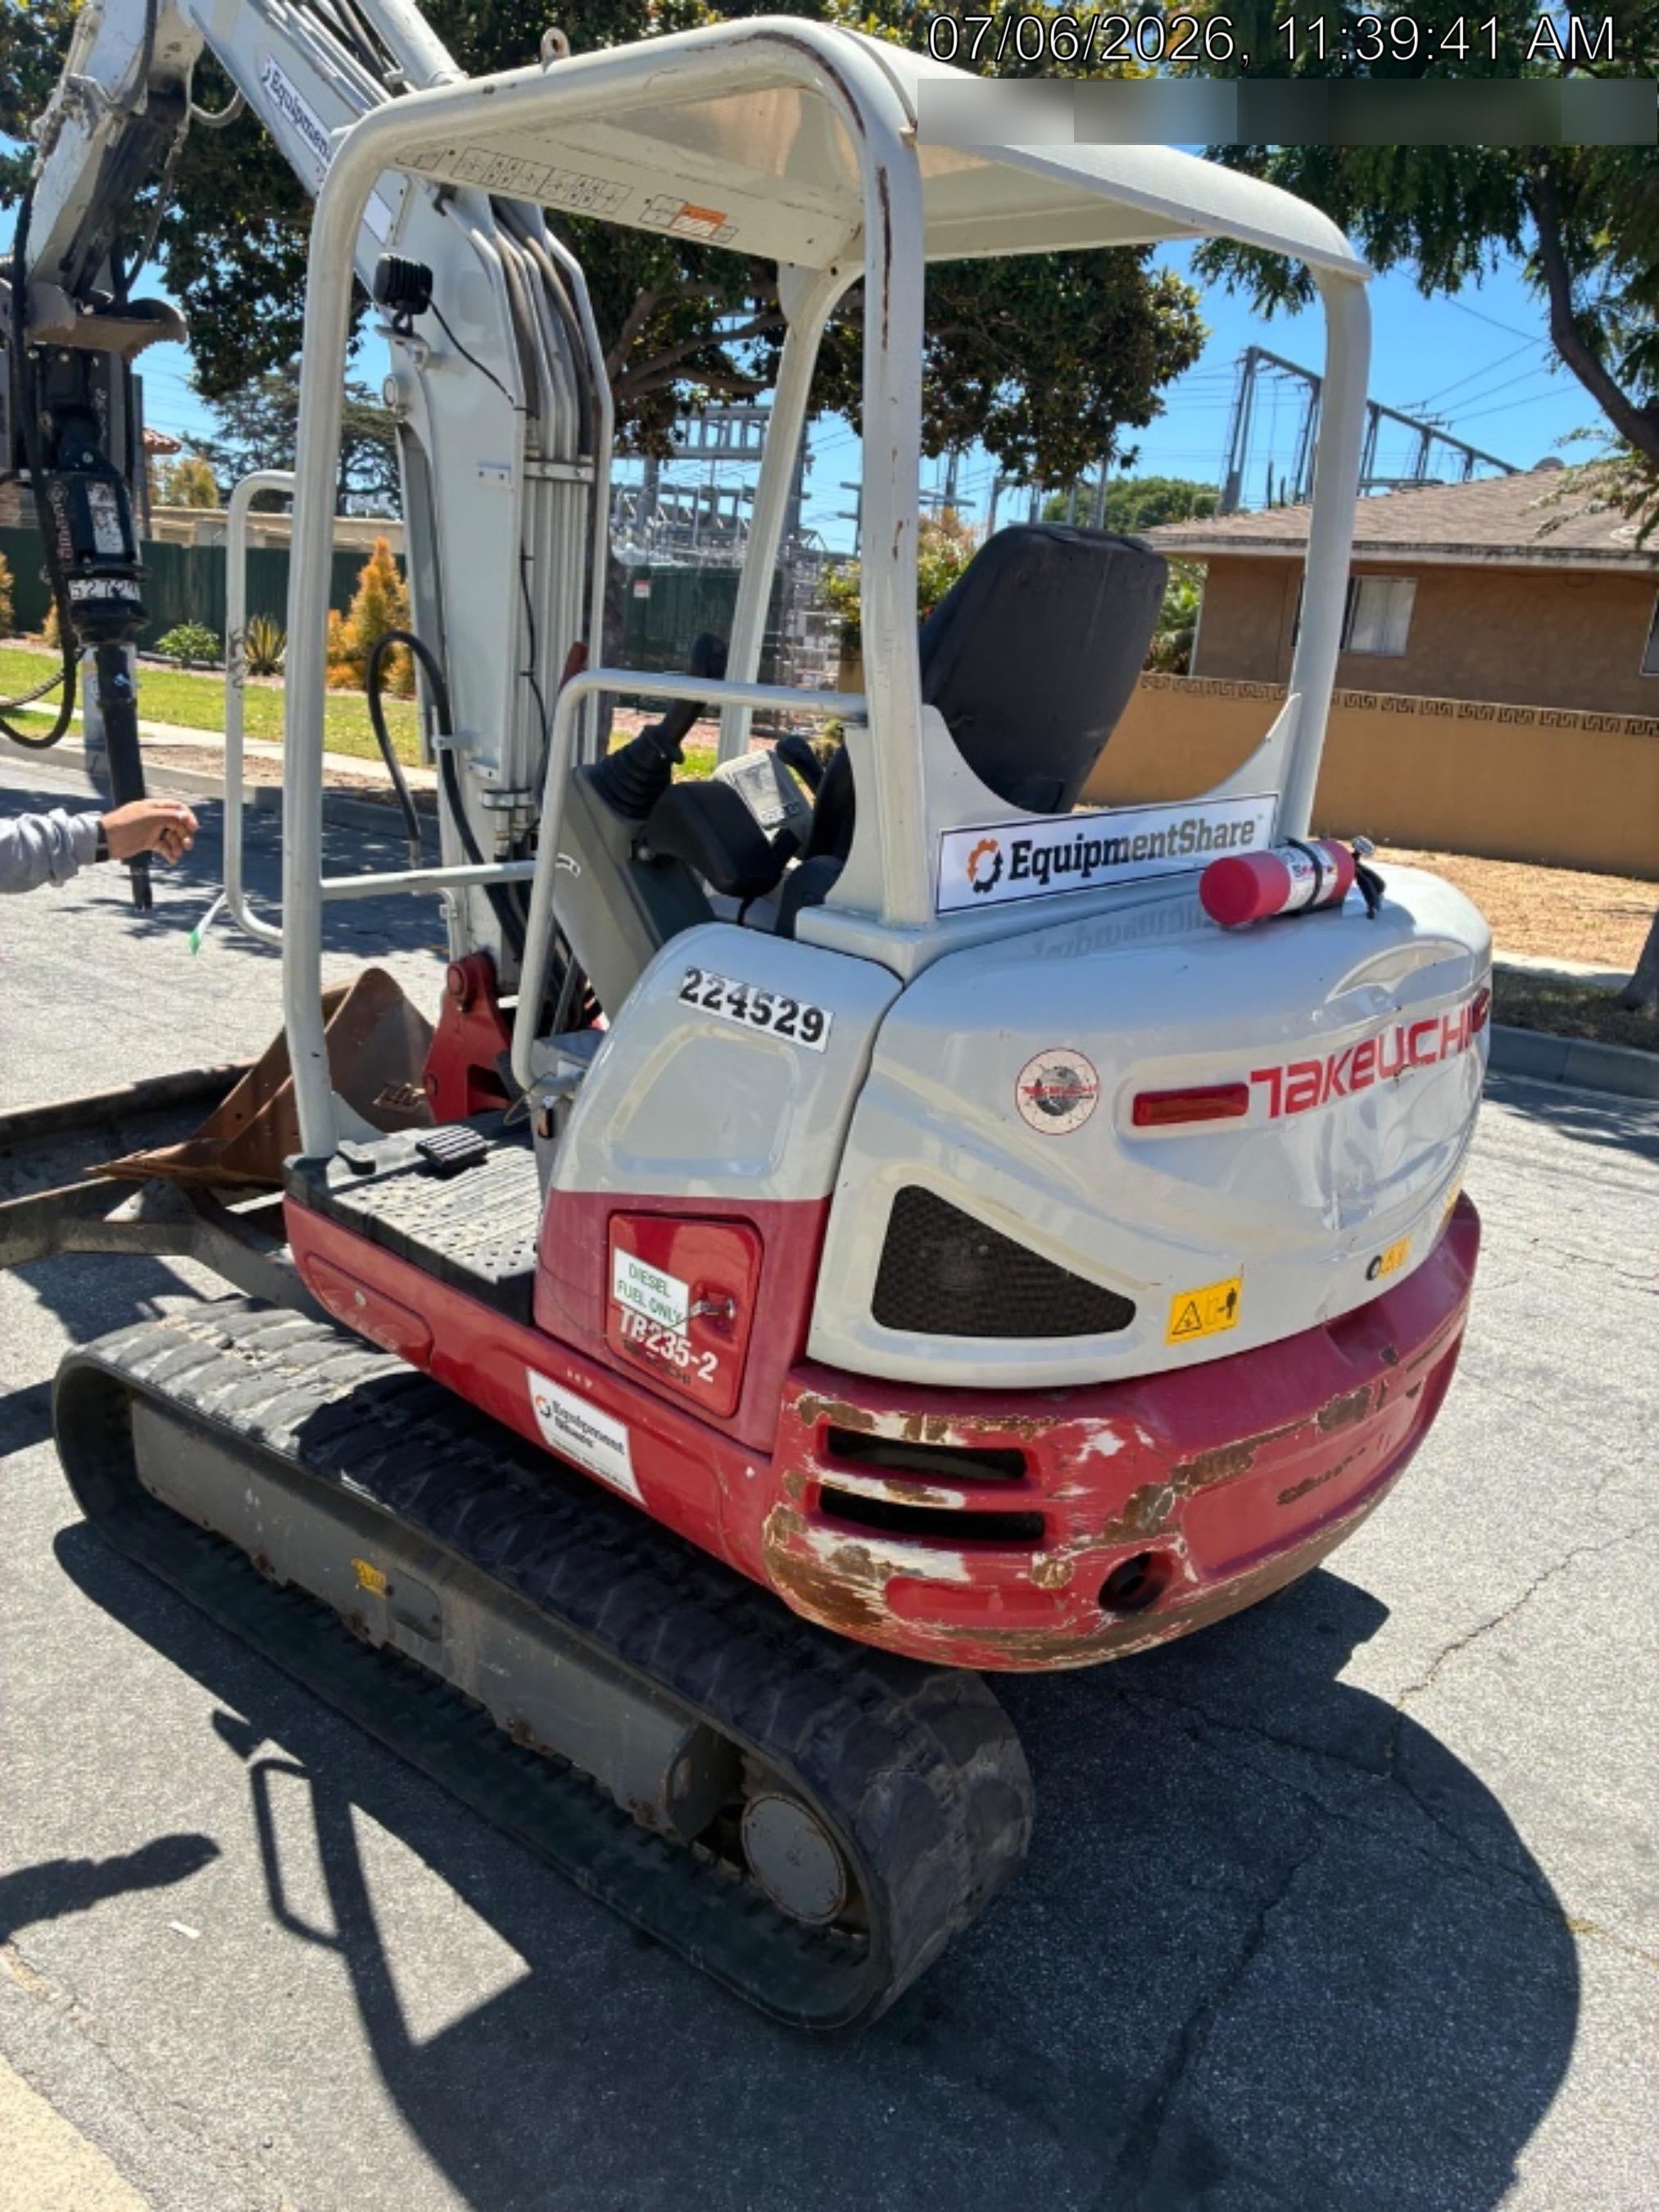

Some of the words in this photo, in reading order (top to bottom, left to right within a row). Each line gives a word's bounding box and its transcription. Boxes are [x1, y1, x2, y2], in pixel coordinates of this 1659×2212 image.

[1009, 819, 1255, 886] EquipmentShare
[679, 964, 825, 1043] 224529
[1250, 1002, 1474, 1119] TAKEUCHI
[617, 1279, 647, 1308] FUEL
[648, 1298, 683, 1325] ONLY
[628, 1262, 671, 1298] DIESEL
[619, 1304, 718, 1384] TB235-2
